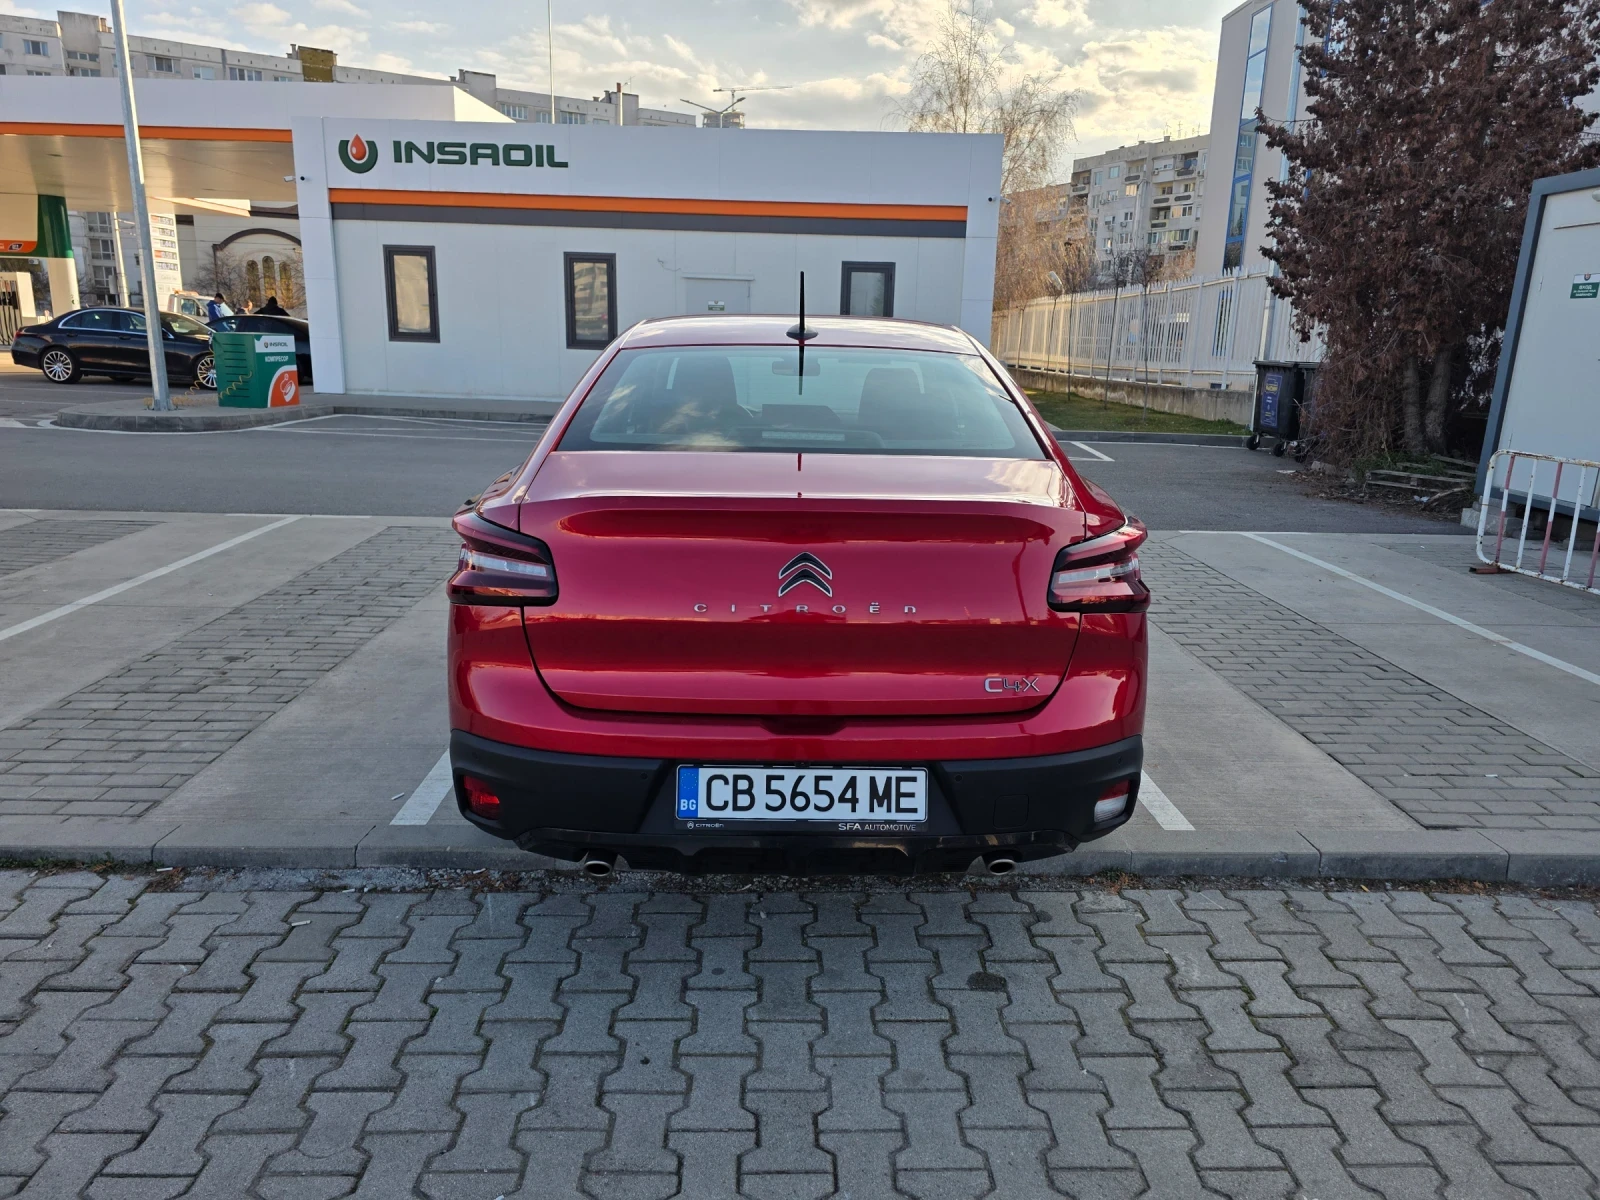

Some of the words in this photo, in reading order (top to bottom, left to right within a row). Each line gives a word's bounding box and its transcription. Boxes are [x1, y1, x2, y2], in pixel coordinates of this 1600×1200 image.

[393, 140, 568, 168] INSAOIL
[984, 677, 1040, 692] C4X
[706, 774, 756, 812] CB
[765, 775, 859, 813] 5654
[869, 775, 918, 814] ME
[680, 799, 697, 811] BG
[838, 823, 862, 831] SFA
